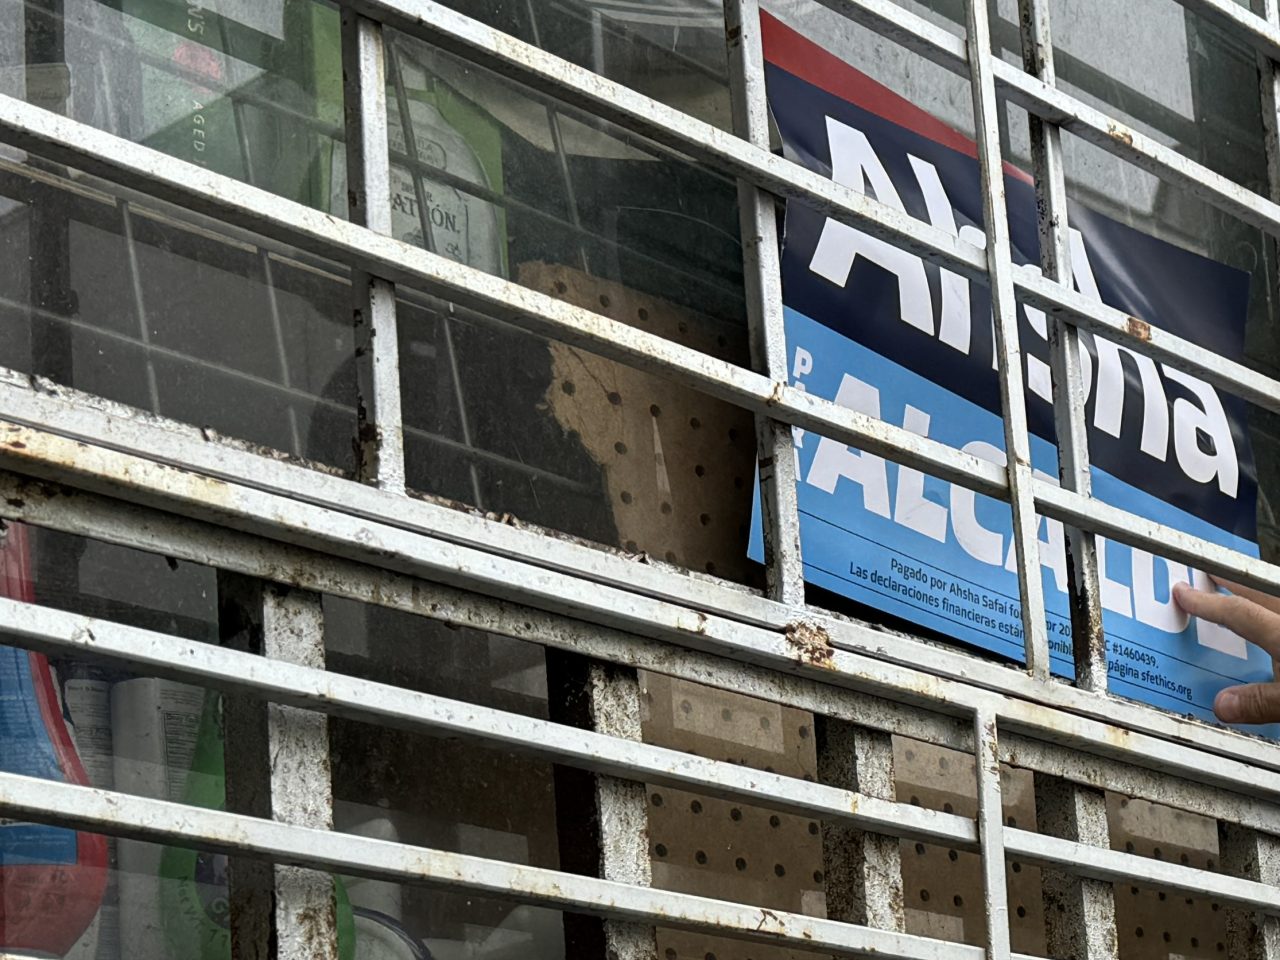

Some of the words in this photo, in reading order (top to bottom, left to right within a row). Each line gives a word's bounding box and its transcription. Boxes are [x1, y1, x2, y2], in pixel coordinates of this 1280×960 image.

[192, 99, 206, 153] AGED
[391, 192, 462, 235] ATÓN.
[849, 561, 868, 580] Las
[870, 569, 940, 608] declaraciones
[942, 596, 997, 629] financieras
[1107, 658, 1140, 680] página
[1141, 670, 1193, 701] sfethics.org
[890, 557, 928, 584] Pagado
[930, 575, 948, 592] por
[949, 582, 980, 605] Ahsha
[1008, 603, 1022, 619] fo
[1112, 641, 1160, 669] #1460439.
